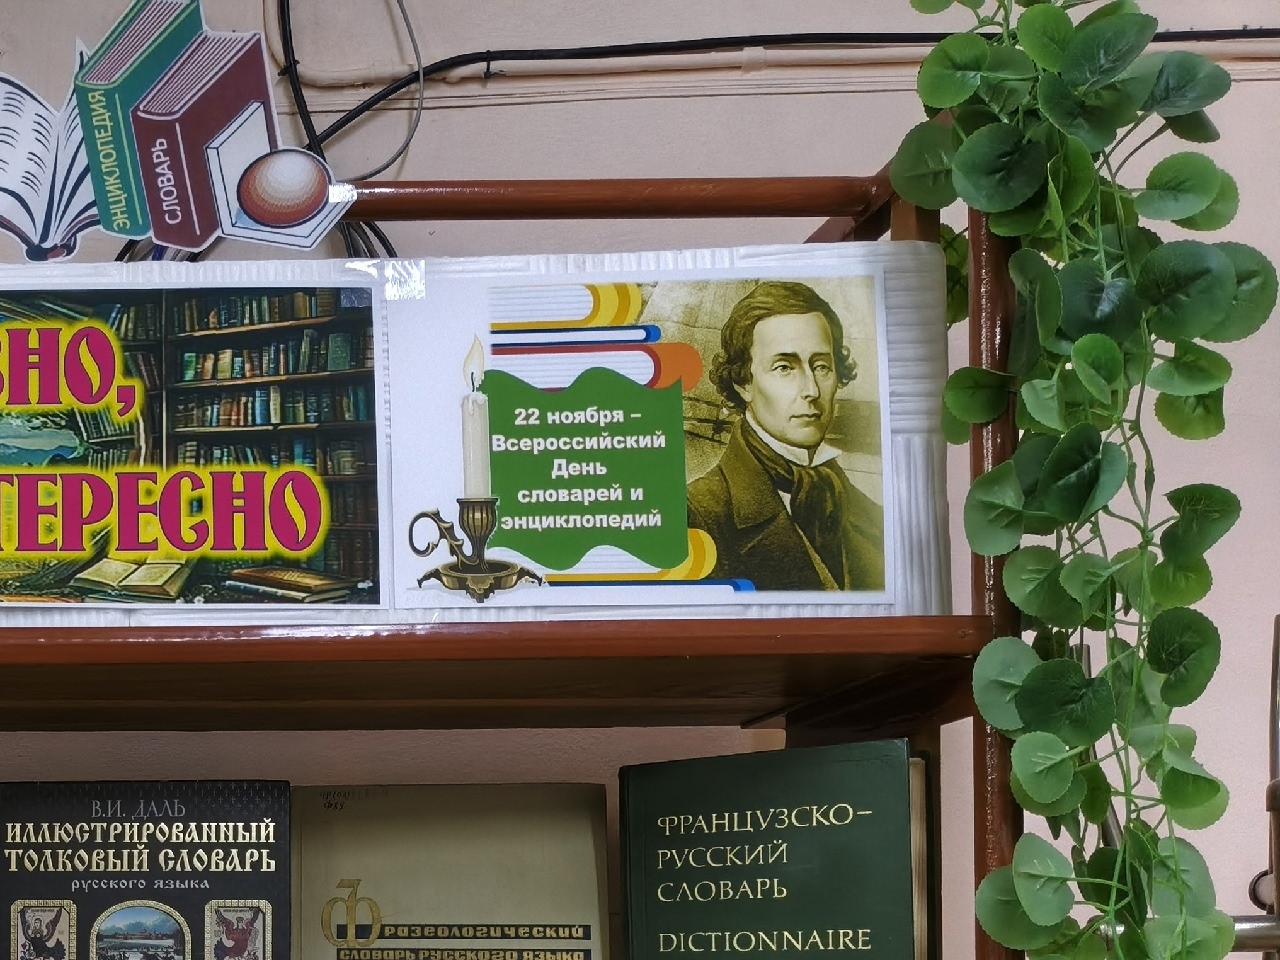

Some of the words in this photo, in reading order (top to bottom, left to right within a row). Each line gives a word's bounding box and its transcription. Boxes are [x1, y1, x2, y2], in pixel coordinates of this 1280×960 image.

[87, 90, 131, 230] ЭНЦИКЛОПЕДИЯ
[150, 138, 182, 226] СЛОВАРЬ
[514, 408, 540, 425] 22
[547, 406, 624, 426] ноября
[491, 430, 666, 454] Всероссийский
[551, 458, 608, 479] День
[518, 483, 623, 505] словарей
[631, 488, 644, 501] и
[501, 508, 662, 531] энциклопедий
[92, 801, 125, 818] В.И.
[132, 800, 186, 820] ДАЛЬ
[5, 818, 276, 843] ИЛЛЮСТРИРОВАННЫЙ
[4, 844, 150, 872] ТОЛКОВЫЙ
[158, 848, 276, 873] СЛОВАРЬ
[657, 840, 789, 869] РУССКИЙ
[71, 879, 147, 893] русского
[154, 879, 210, 890] языка
[657, 878, 788, 902] СЛОВАРЬ
[659, 929, 872, 953] DICTIONNAIRE
